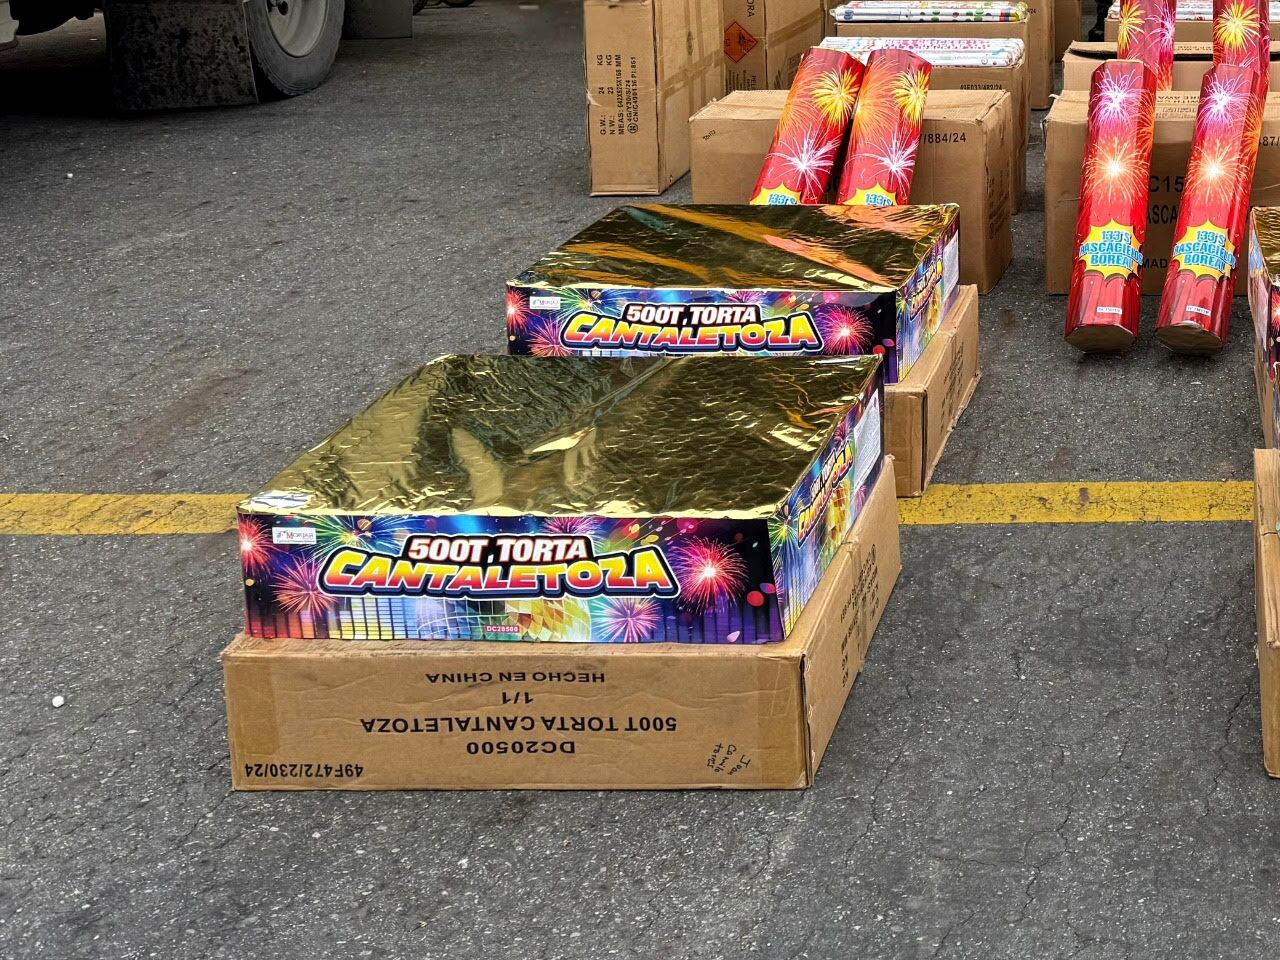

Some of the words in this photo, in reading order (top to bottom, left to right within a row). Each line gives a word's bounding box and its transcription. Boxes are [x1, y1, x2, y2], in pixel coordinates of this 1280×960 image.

[597, 54, 603, 66] KG
[606, 54, 612, 66] KG
[614, 54, 622, 66] MM
[922, 132, 966, 144] /884/24
[1142, 258, 1168, 268] MAD
[626, 306, 680, 322] 500T
[687, 306, 757, 325] TORTA
[564, 314, 818, 347] CANTALETOZA
[408, 538, 488, 562] 500T
[496, 539, 588, 562] TORTA
[326, 550, 672, 590] CANTALETOZA
[426, 672, 492, 683] CHINA
[500, 672, 526, 682] EN
[533, 672, 605, 683] HECHO
[502, 692, 534, 704] 1/1
[360, 717, 535, 732] CANTALETOZA
[542, 716, 614, 732] TORTA
[625, 717, 677, 732] 500T
[466, 741, 576, 755] DC20500
[244, 764, 364, 778] 49F472/230/24
